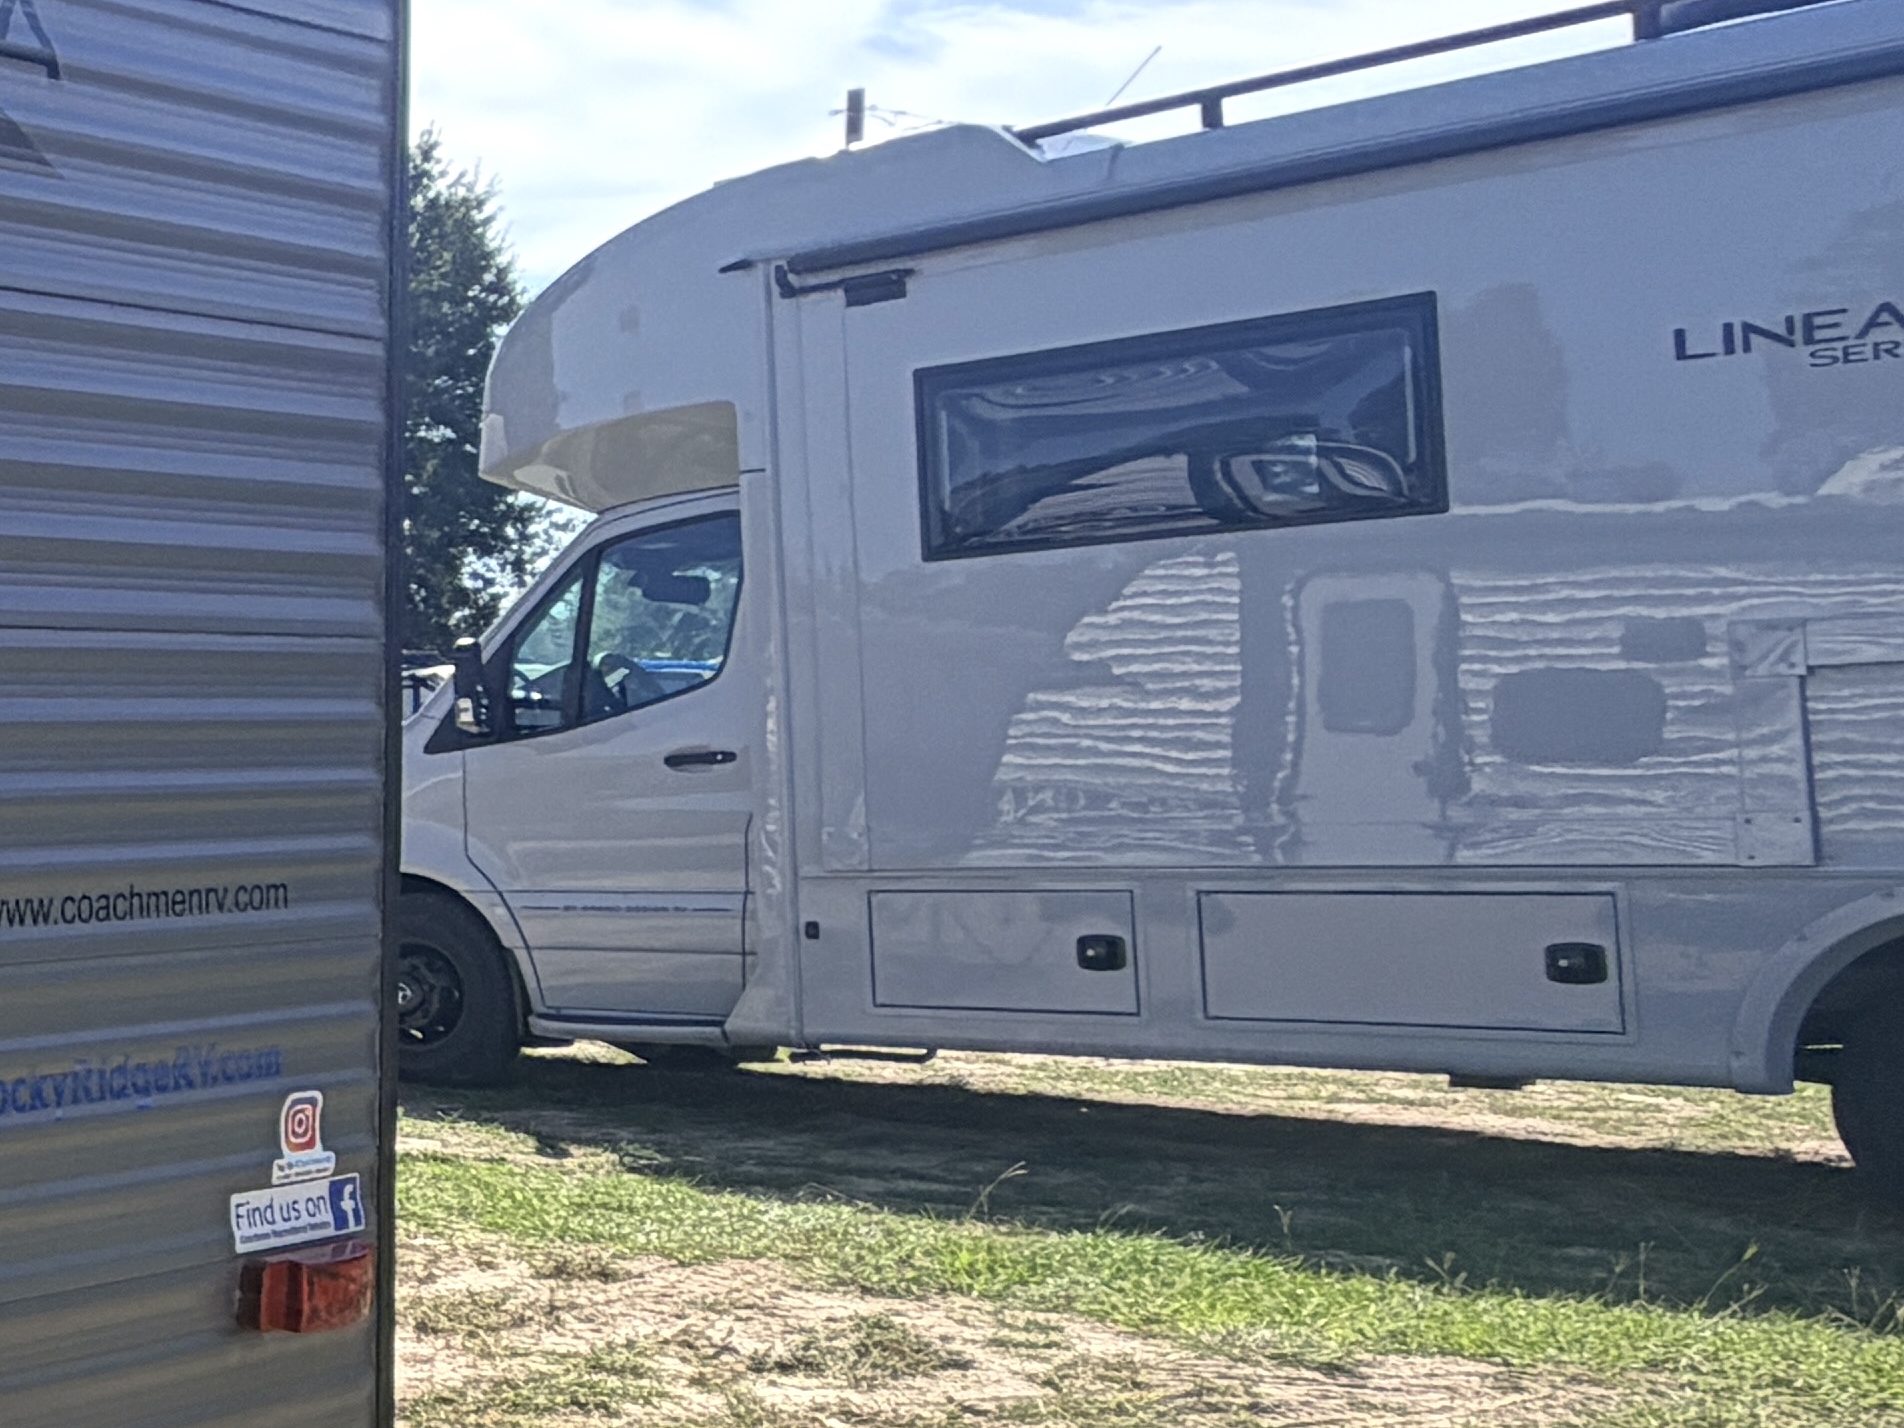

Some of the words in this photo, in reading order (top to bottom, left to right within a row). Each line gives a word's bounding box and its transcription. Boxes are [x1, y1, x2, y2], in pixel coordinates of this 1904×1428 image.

[234, 1195, 276, 1231] Find
[280, 1200, 302, 1223] us
[305, 1194, 329, 1218] on
